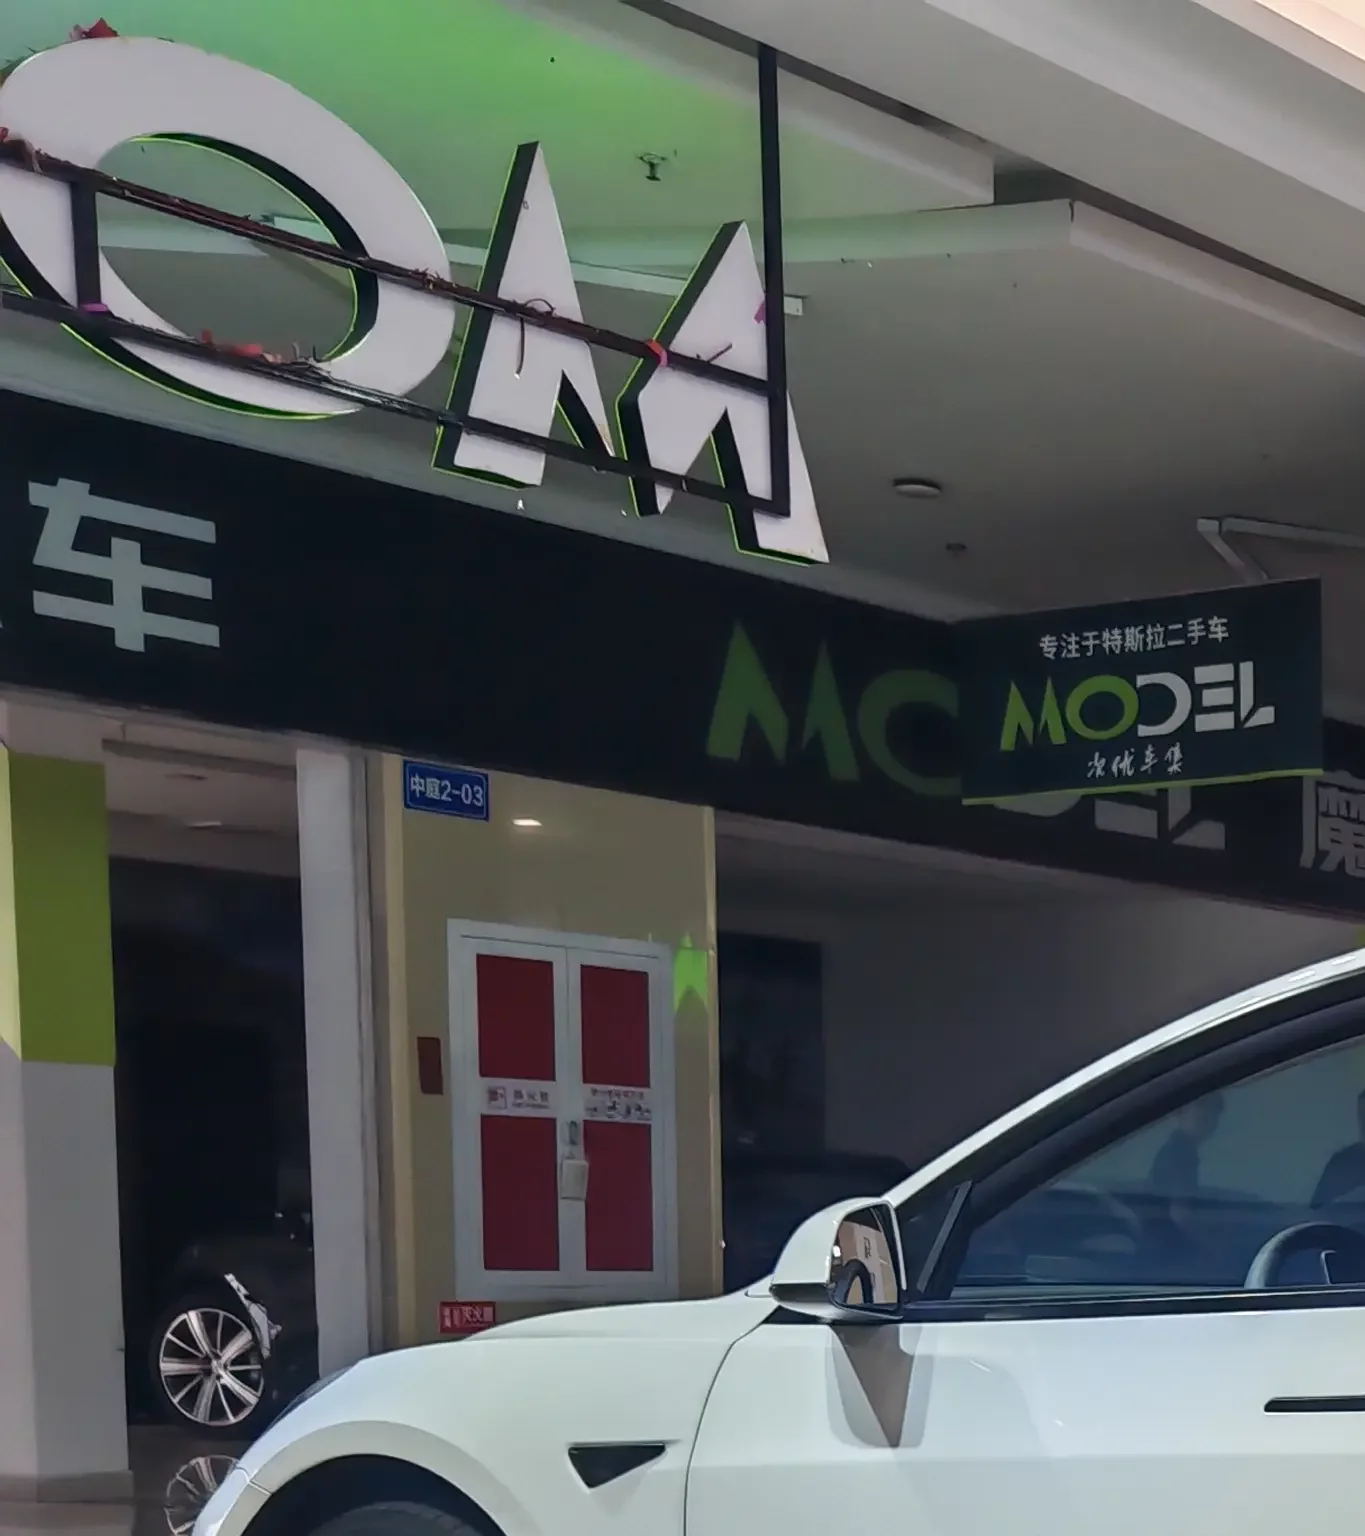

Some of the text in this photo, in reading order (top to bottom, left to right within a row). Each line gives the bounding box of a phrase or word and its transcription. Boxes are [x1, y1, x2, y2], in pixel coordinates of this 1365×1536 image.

[28, 479, 220, 653] 车
[1039, 616, 1229, 660] 专注于特斯拉二手车
[1001, 660, 1275, 751] MODEL
[410, 773, 484, 807] 中庭2-03
